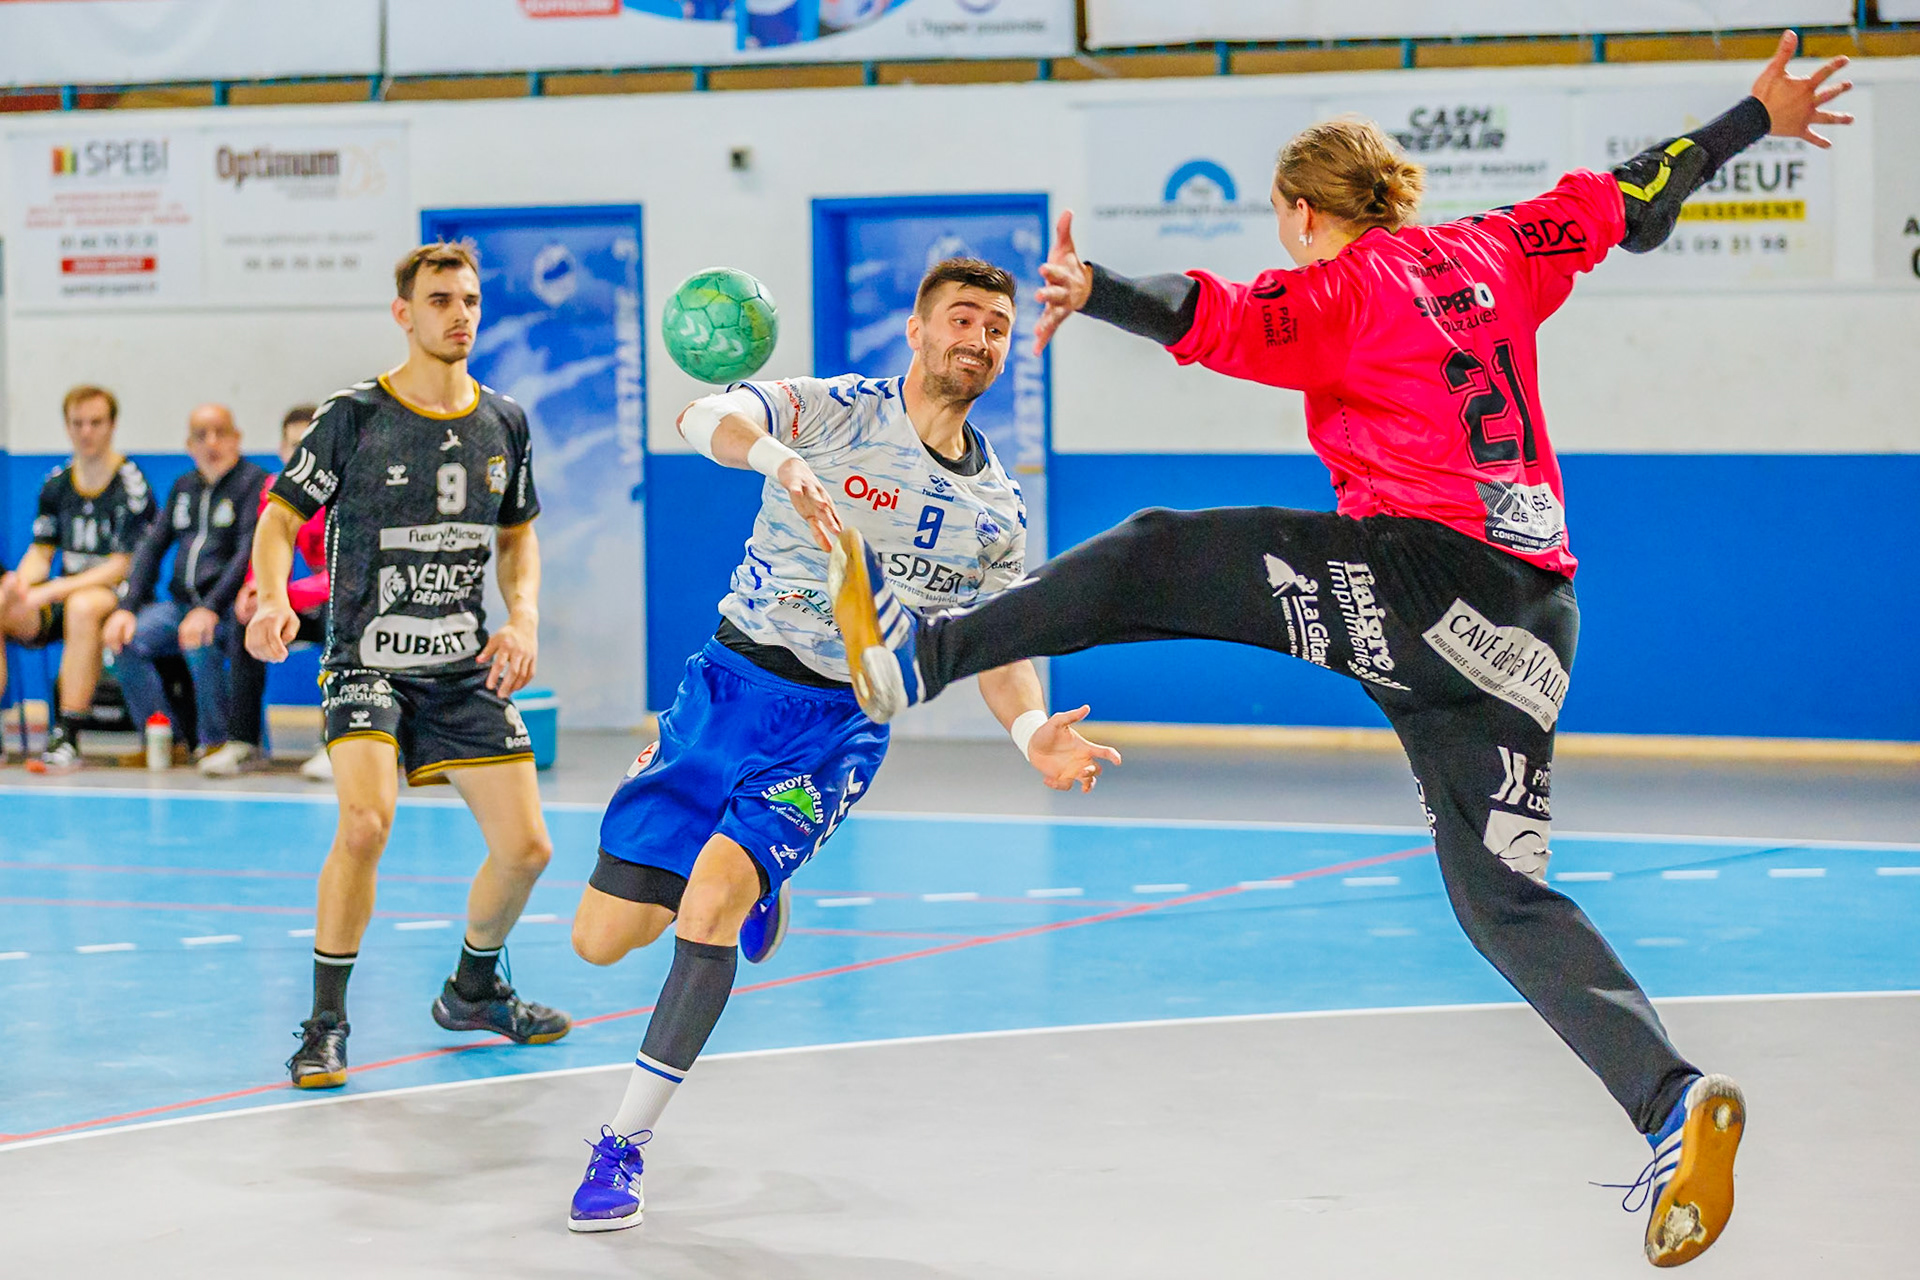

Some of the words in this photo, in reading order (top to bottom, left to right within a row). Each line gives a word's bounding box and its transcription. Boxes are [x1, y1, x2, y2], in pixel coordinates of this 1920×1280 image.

[1409, 106, 1492, 128] CASH
[216, 144, 340, 188] Optimum
[1413, 286, 1477, 318] SUPER
[1261, 304, 1278, 348] LOIRE
[1279, 306, 1293, 344] PAYS
[1440, 338, 1538, 469] 21
[436, 462, 467, 515] 9
[845, 475, 899, 510] Orpi
[913, 504, 944, 549] 9
[1298, 595, 1320, 621] La
[376, 630, 467, 655] PUBERT
[1431, 633, 1467, 667] POUZAUGES
[1450, 614, 1503, 660] CAVE
[1491, 642, 1514, 671] de
[1522, 650, 1566, 708] VALLE
[761, 775, 801, 799] LEROY
[803, 774, 824, 824] MERLIN
